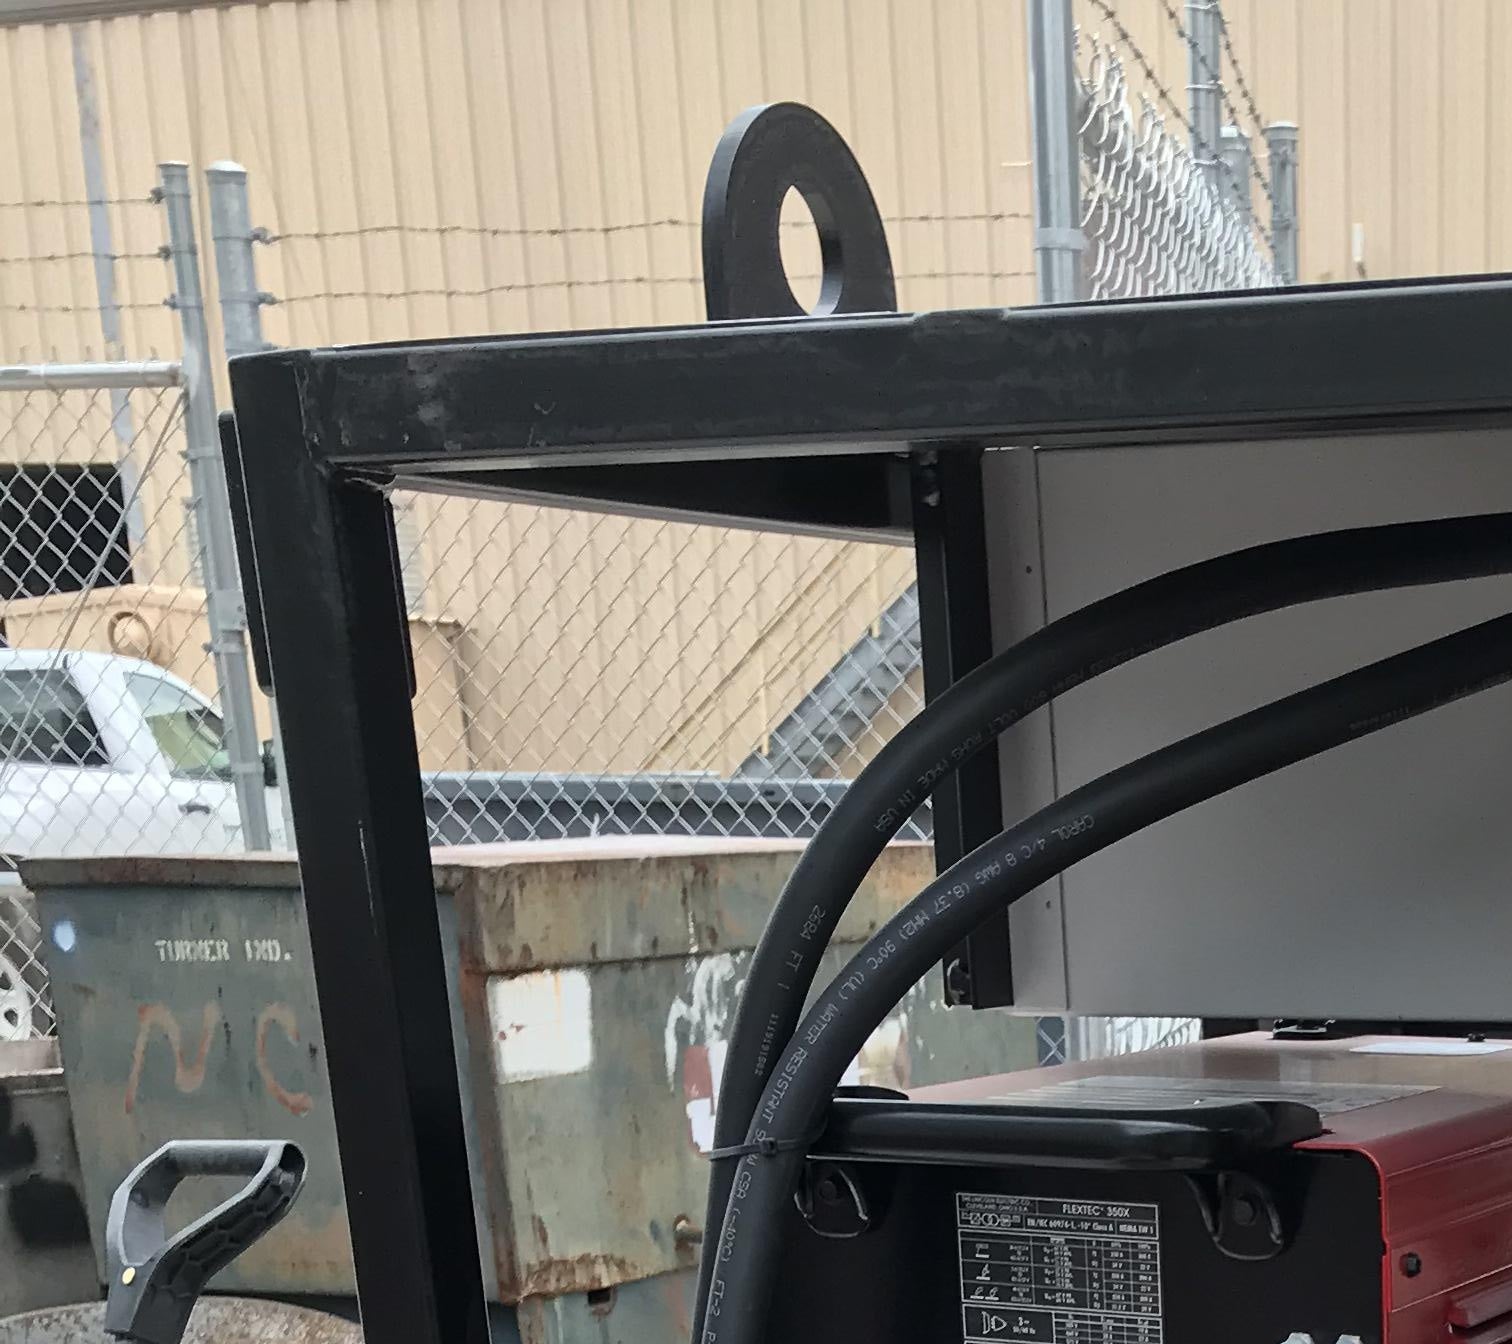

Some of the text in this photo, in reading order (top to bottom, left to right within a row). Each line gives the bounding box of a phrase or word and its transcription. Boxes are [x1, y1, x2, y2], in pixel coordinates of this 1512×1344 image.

[898, 790, 915, 806] IN
[874, 808, 897, 831] USA
[1051, 815, 1095, 841] CAROL
[1021, 838, 1047, 859] 4/C
[975, 863, 1001, 885] AWG
[838, 971, 866, 1001] (UL)
[806, 1003, 842, 1046] WATER
[761, 1046, 809, 1124] RESISTANT
[746, 1129, 767, 1167] SW
[736, 1171, 753, 1199] CSA
[1107, 1207, 1130, 1218] 350X
